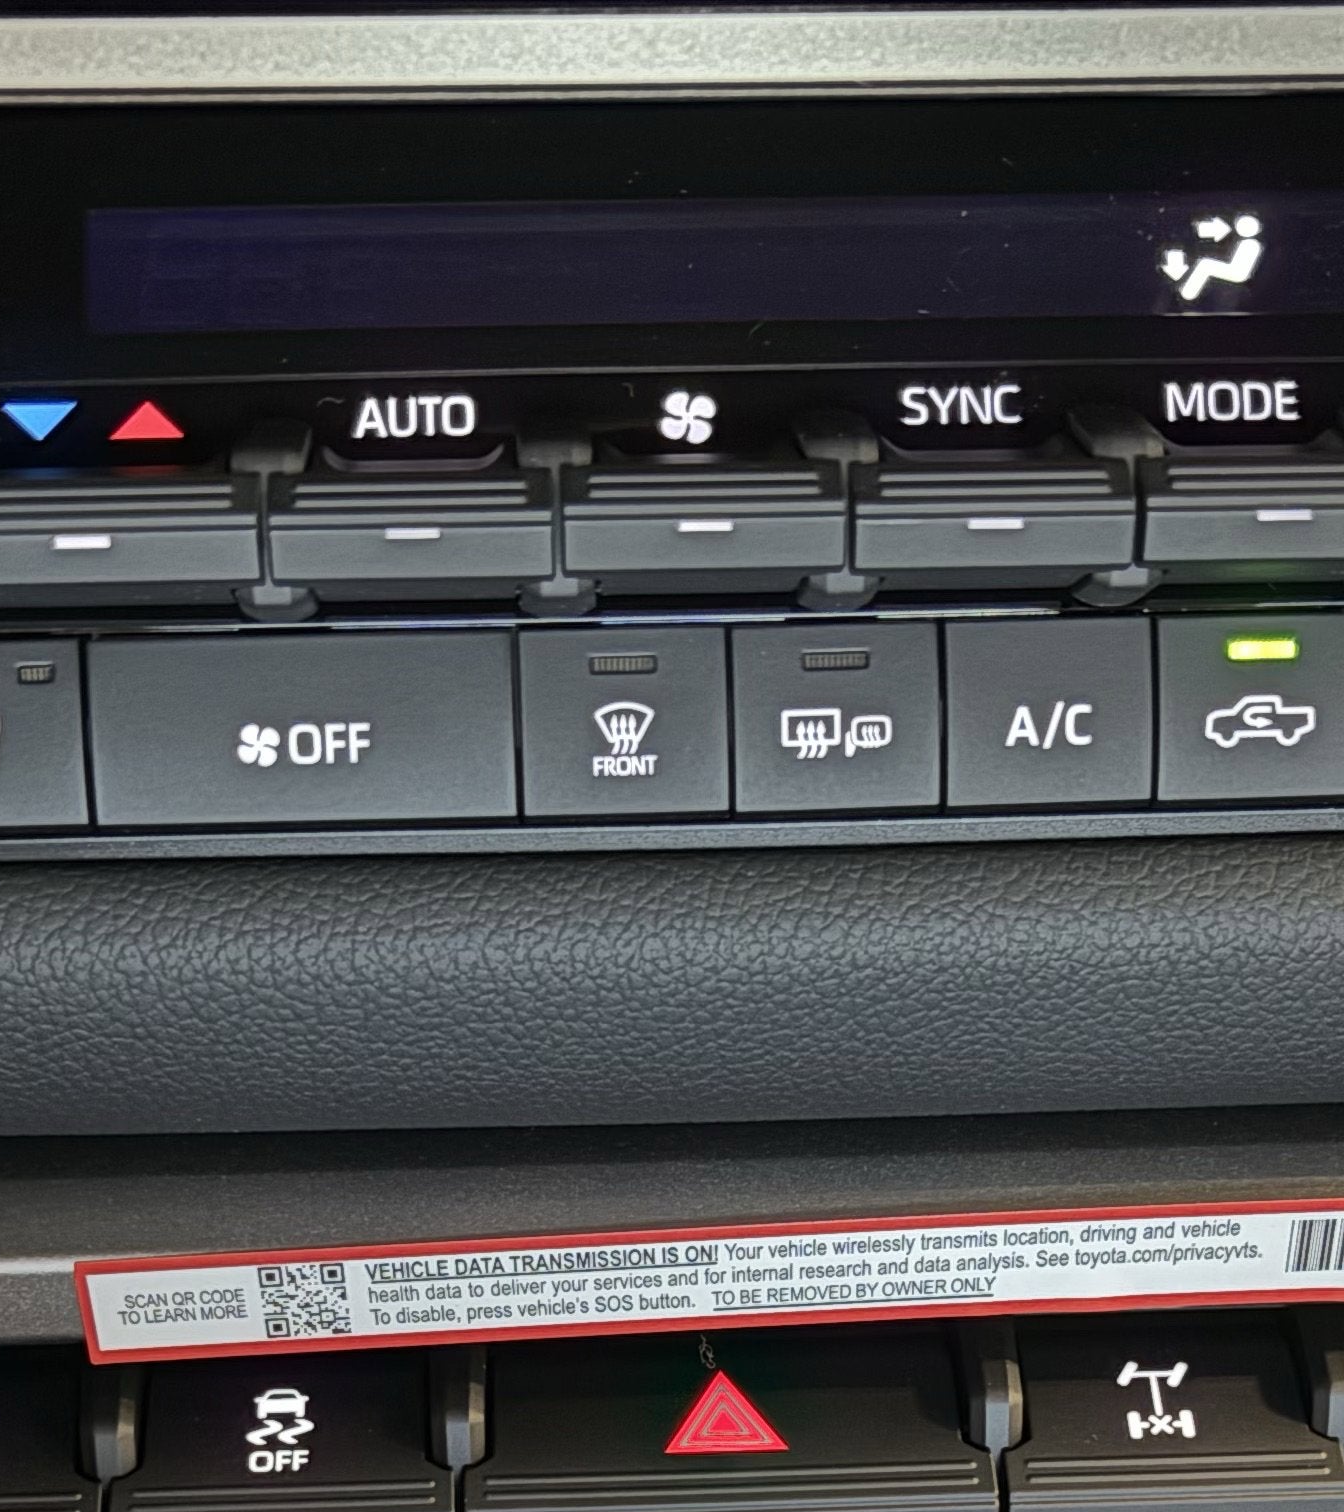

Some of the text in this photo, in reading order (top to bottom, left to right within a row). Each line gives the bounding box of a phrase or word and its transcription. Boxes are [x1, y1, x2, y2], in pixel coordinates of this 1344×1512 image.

[353, 395, 476, 438] AUTO
[901, 384, 1022, 426] SYNC
[1165, 380, 1300, 422] MODE
[288, 721, 371, 765] OFF
[1004, 700, 1094, 750] A/C
[591, 755, 659, 778] FRONT
[365, 1219, 1241, 1281] VEHICLE DATA TRANSMISSION IS ON! Your vehicle wirelessly transmits location, driving and vehicle
[368, 1242, 1263, 1303] health data to deliver your services and for internal research and data analysis. See toyota.com/privacyvts.
[118, 1305, 249, 1325] TO LEARN MORE
[124, 1288, 245, 1309] SCAN QR CODE
[369, 1276, 996, 1325] To disable, press vehicle's SOS button. TO BE REMOVED BY OWNER ONLY
[248, 1449, 310, 1473] OFF
